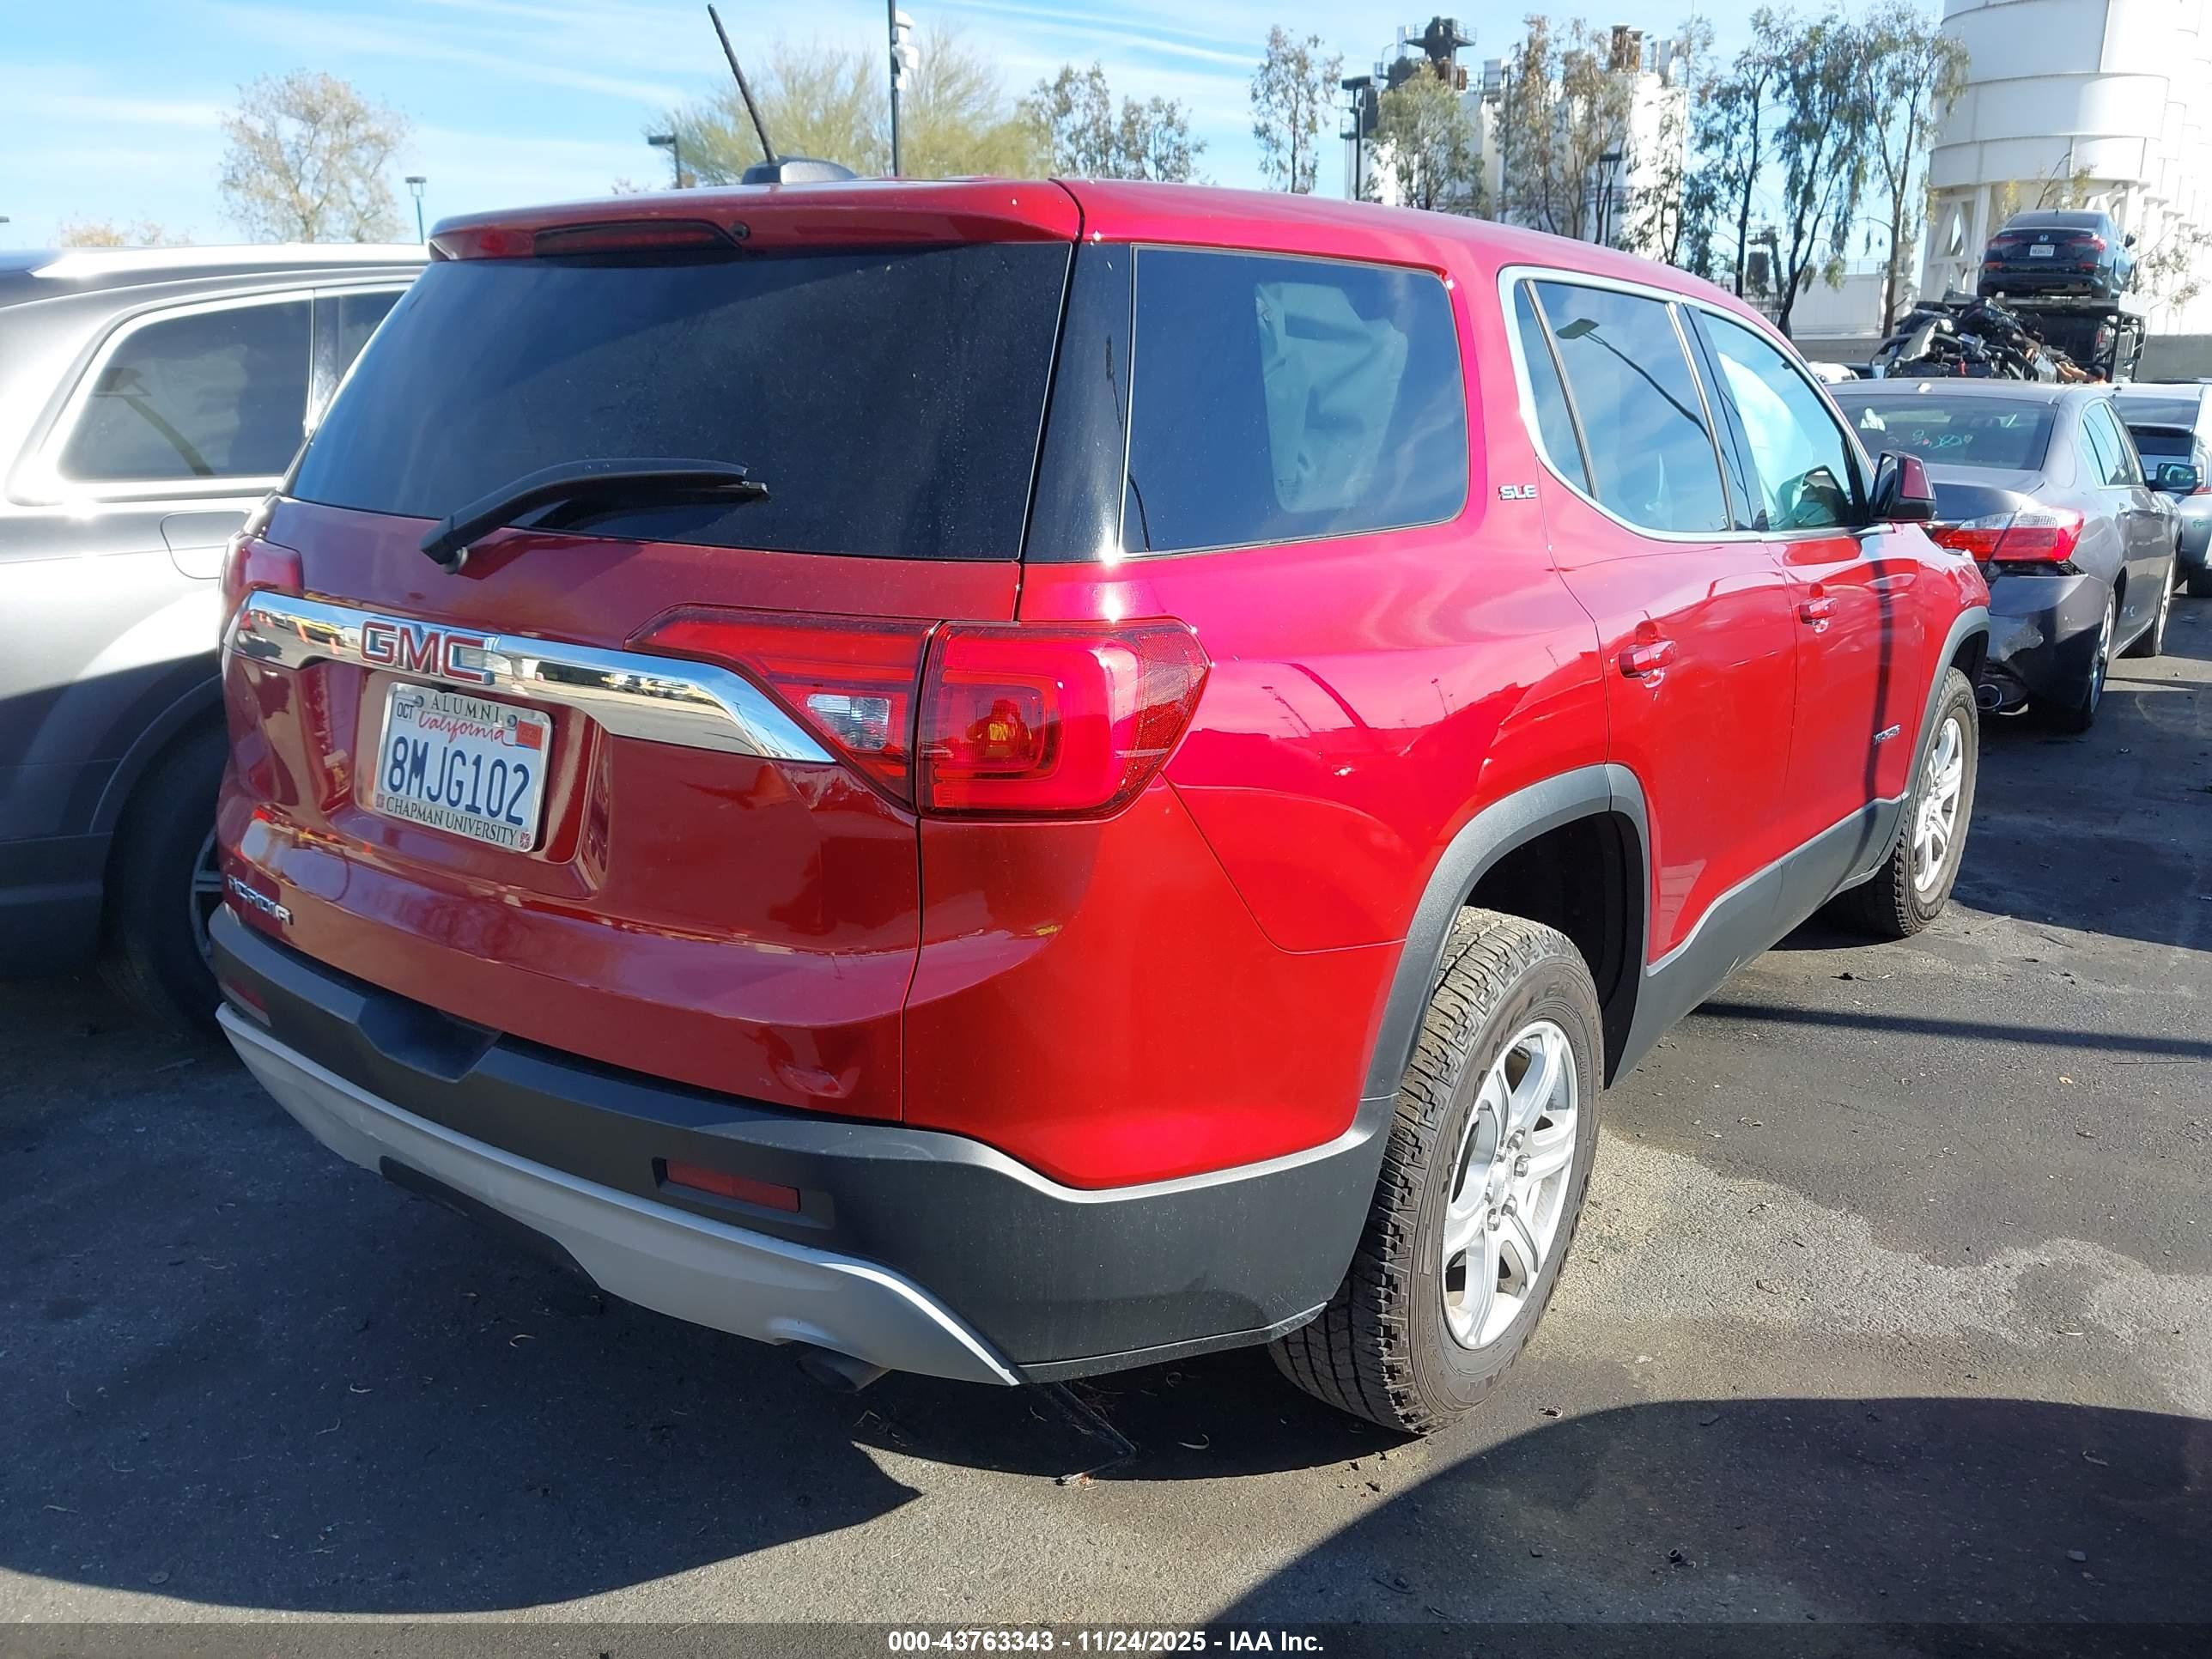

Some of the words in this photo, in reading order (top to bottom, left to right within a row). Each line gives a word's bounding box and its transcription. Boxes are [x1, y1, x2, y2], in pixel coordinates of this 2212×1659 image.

[1498, 484, 1537, 501] SLE
[360, 620, 495, 685] GMC
[397, 702, 415, 720] OCT
[431, 695, 501, 723] ALUMNI
[418, 711, 516, 747] California
[388, 736, 530, 826] 8MJG102
[386, 796, 443, 827] CHAPMAN
[446, 813, 517, 847] UNIVERSITY
